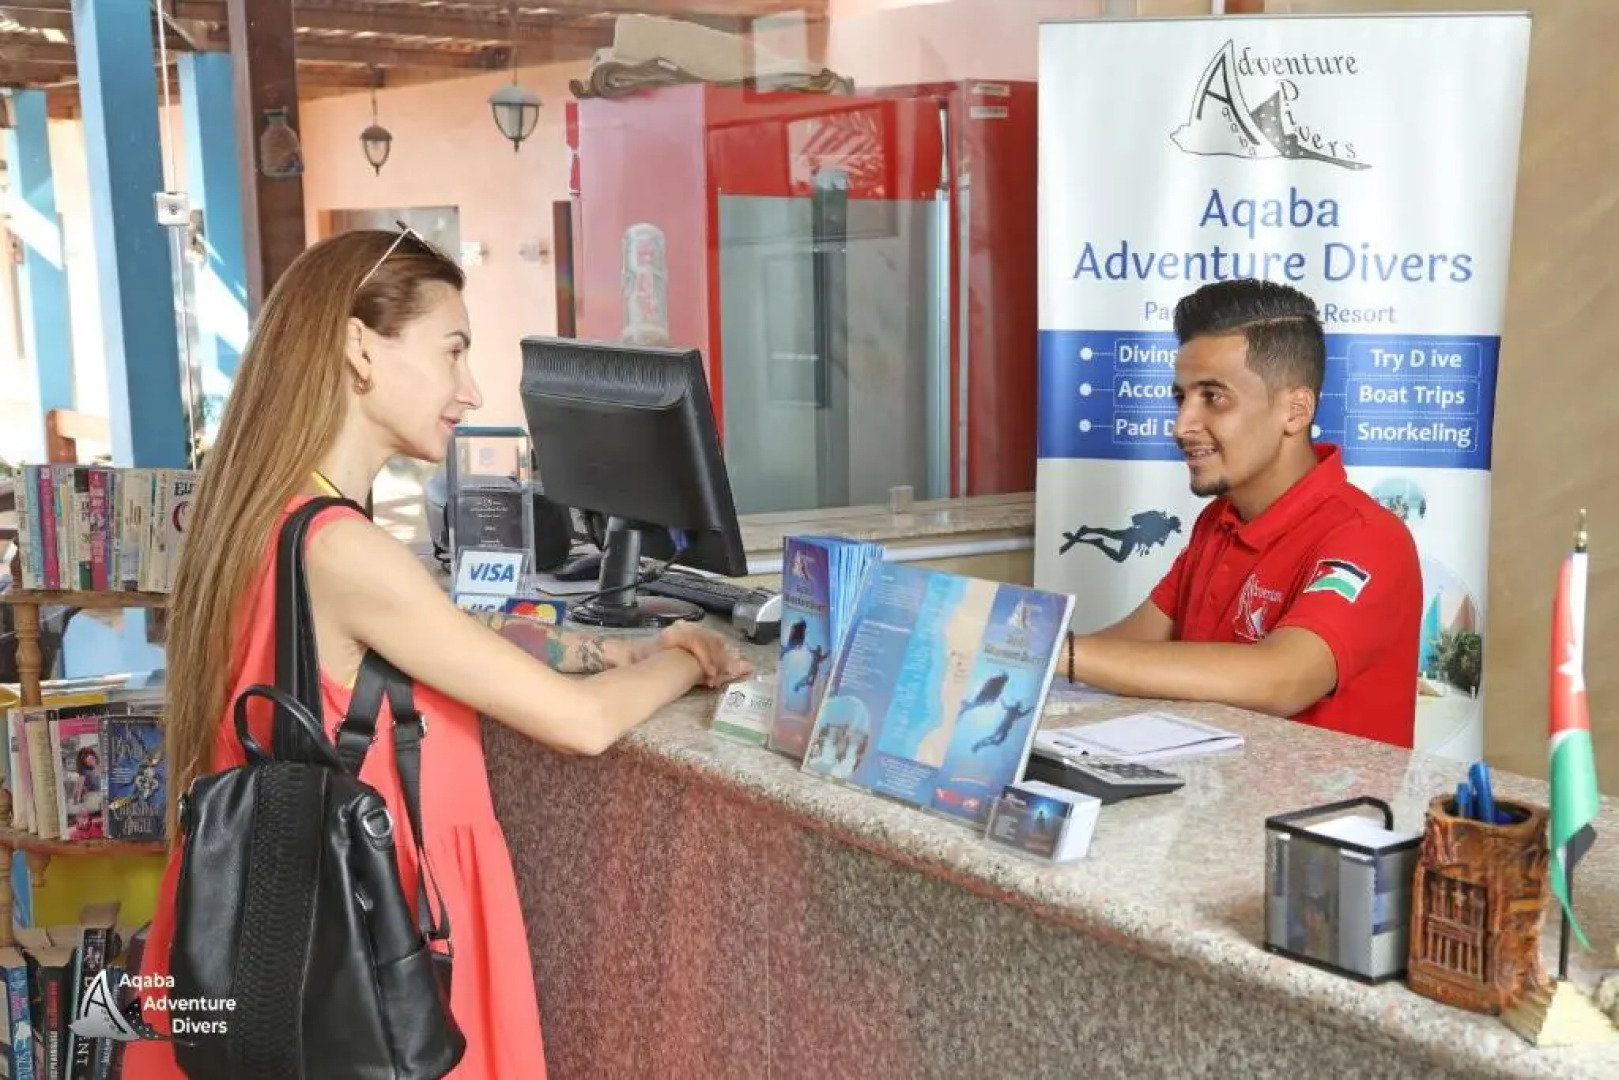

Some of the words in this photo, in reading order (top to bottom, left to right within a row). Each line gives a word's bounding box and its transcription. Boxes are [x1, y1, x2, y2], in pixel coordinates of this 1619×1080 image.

[1199, 187, 1339, 239] Aqaba
[1073, 241, 1306, 281] Adventure
[1324, 243, 1474, 283] Divers
[1324, 303, 1398, 323] Resort
[1370, 349, 1404, 372] Try
[1359, 385, 1408, 404] Boat
[1414, 386, 1466, 409] Trips
[1115, 418, 1157, 436] Padi
[1357, 422, 1472, 448] Snorkeling
[468, 563, 515, 583] VISA
